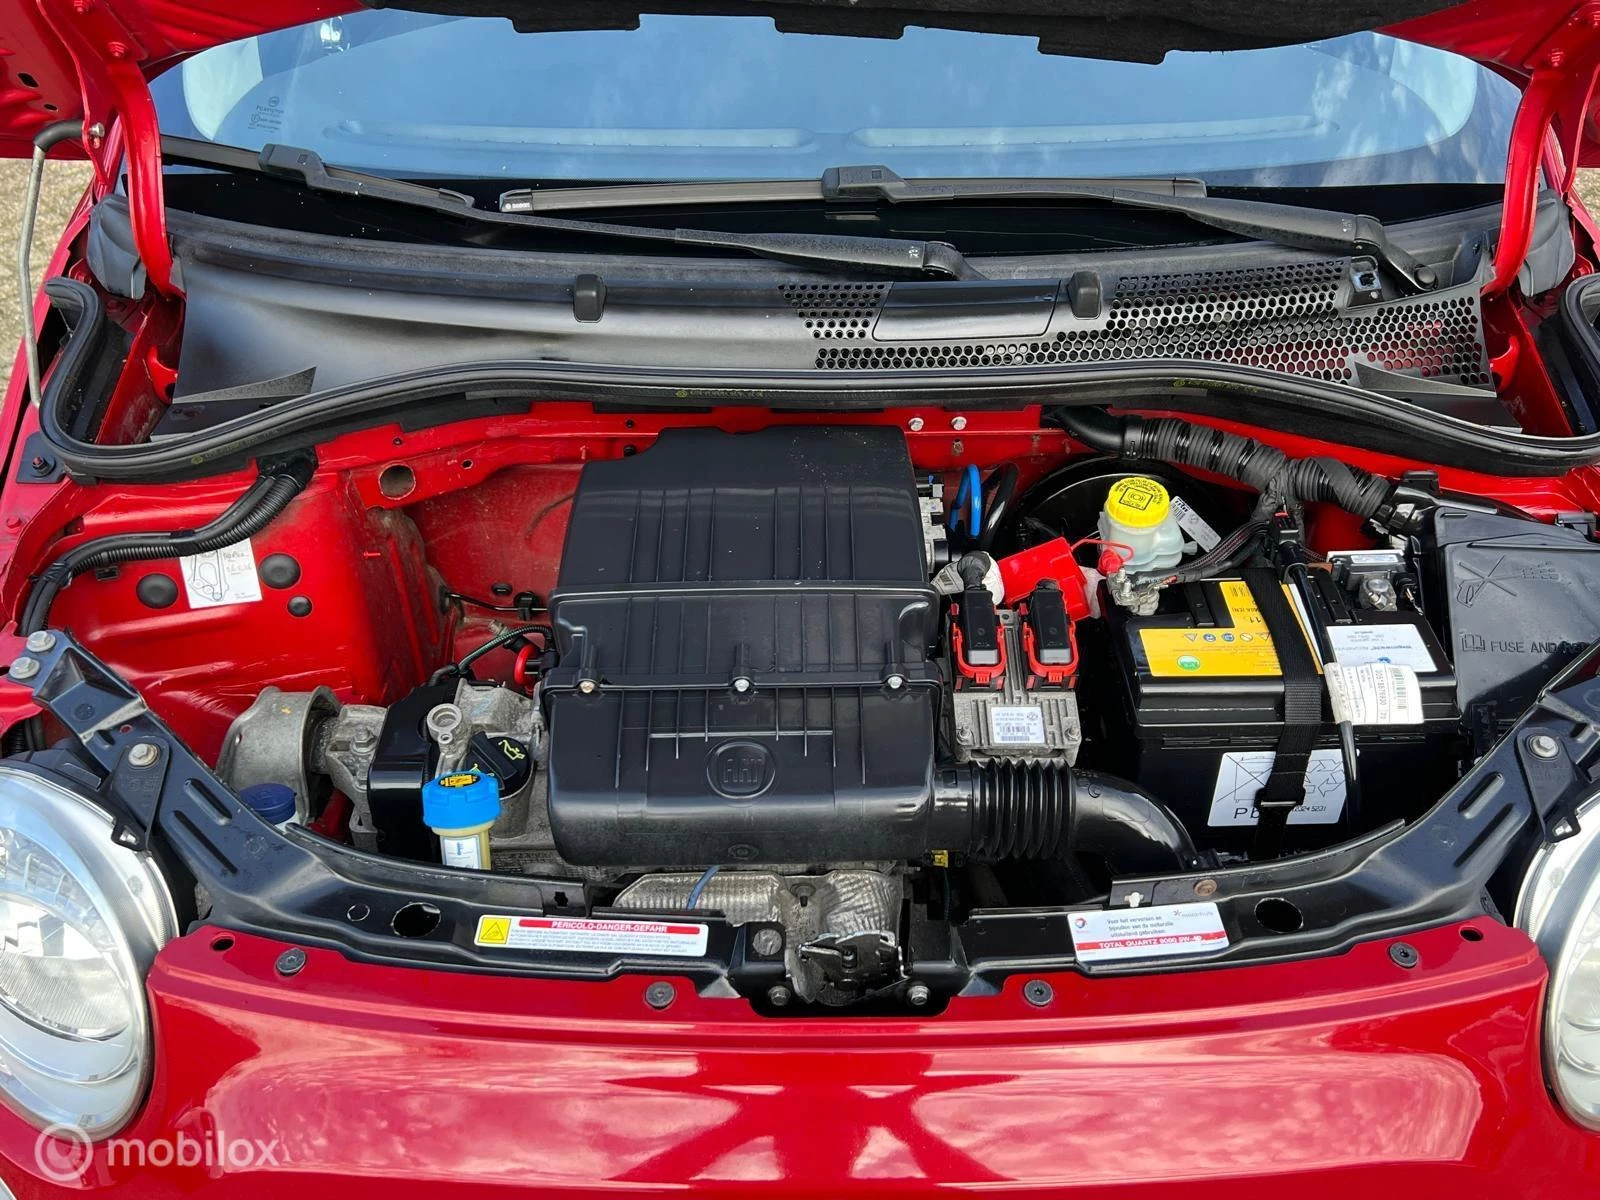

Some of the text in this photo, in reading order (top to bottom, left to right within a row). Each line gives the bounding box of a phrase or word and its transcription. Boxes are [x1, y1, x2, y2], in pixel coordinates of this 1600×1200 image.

[1490, 641, 1525, 654] FUSE
[1530, 641, 1557, 654] AND
[1099, 940, 1122, 949] TOTAL
[1126, 938, 1158, 947] QUARTZ
